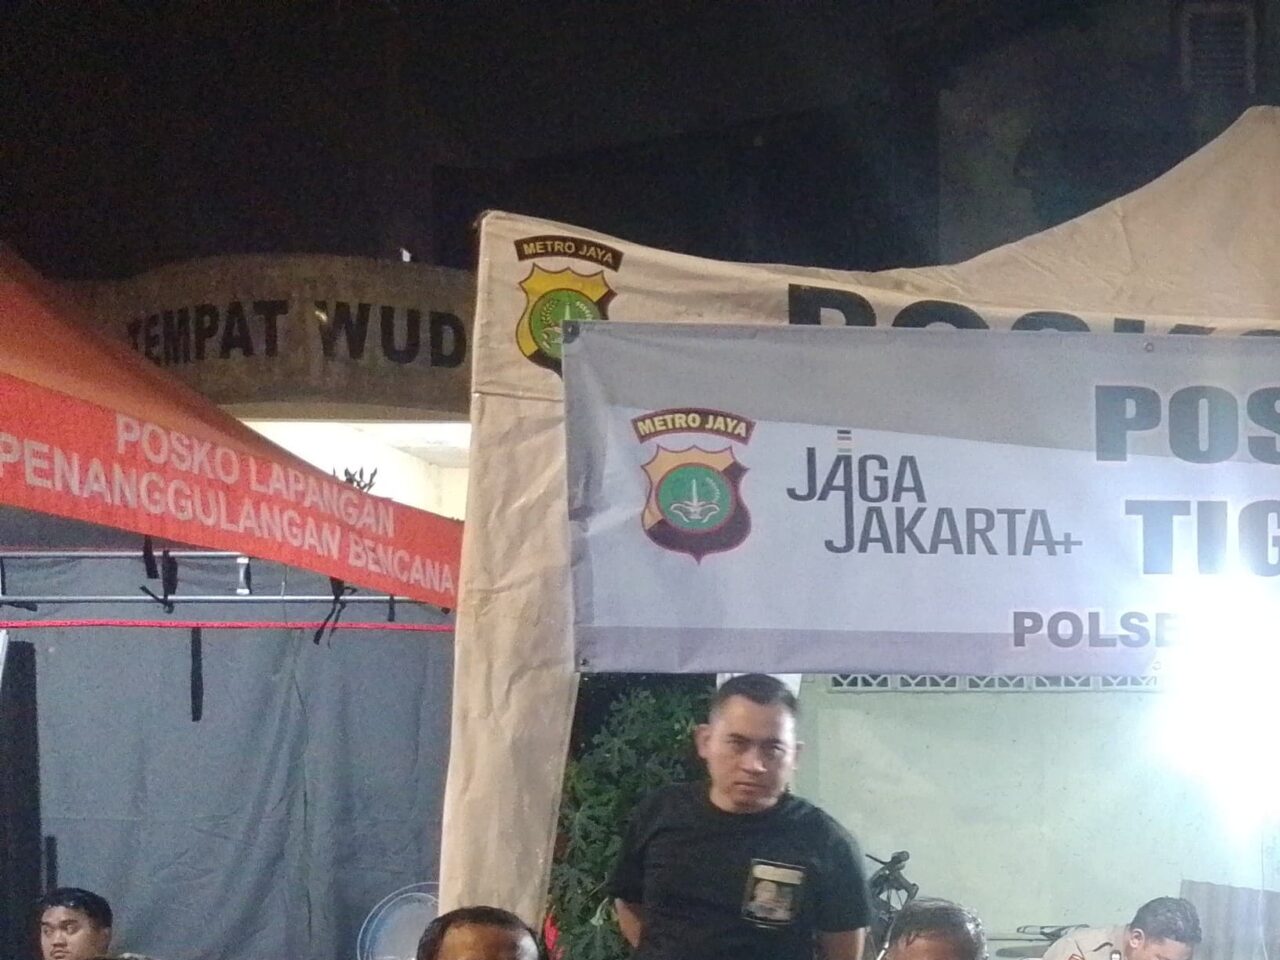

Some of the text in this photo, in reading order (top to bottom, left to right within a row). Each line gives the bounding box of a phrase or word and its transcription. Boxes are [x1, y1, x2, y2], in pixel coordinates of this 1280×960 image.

[522, 240, 614, 265] METRO JAYA
[637, 412, 748, 438] METRO JAYA
[116, 413, 395, 538] POSKO LAPANGAN
[786, 445, 927, 504] JAGA
[0, 432, 456, 596] PENANGGULANGAN BENCANA
[1012, 610, 1184, 649] POLSE
